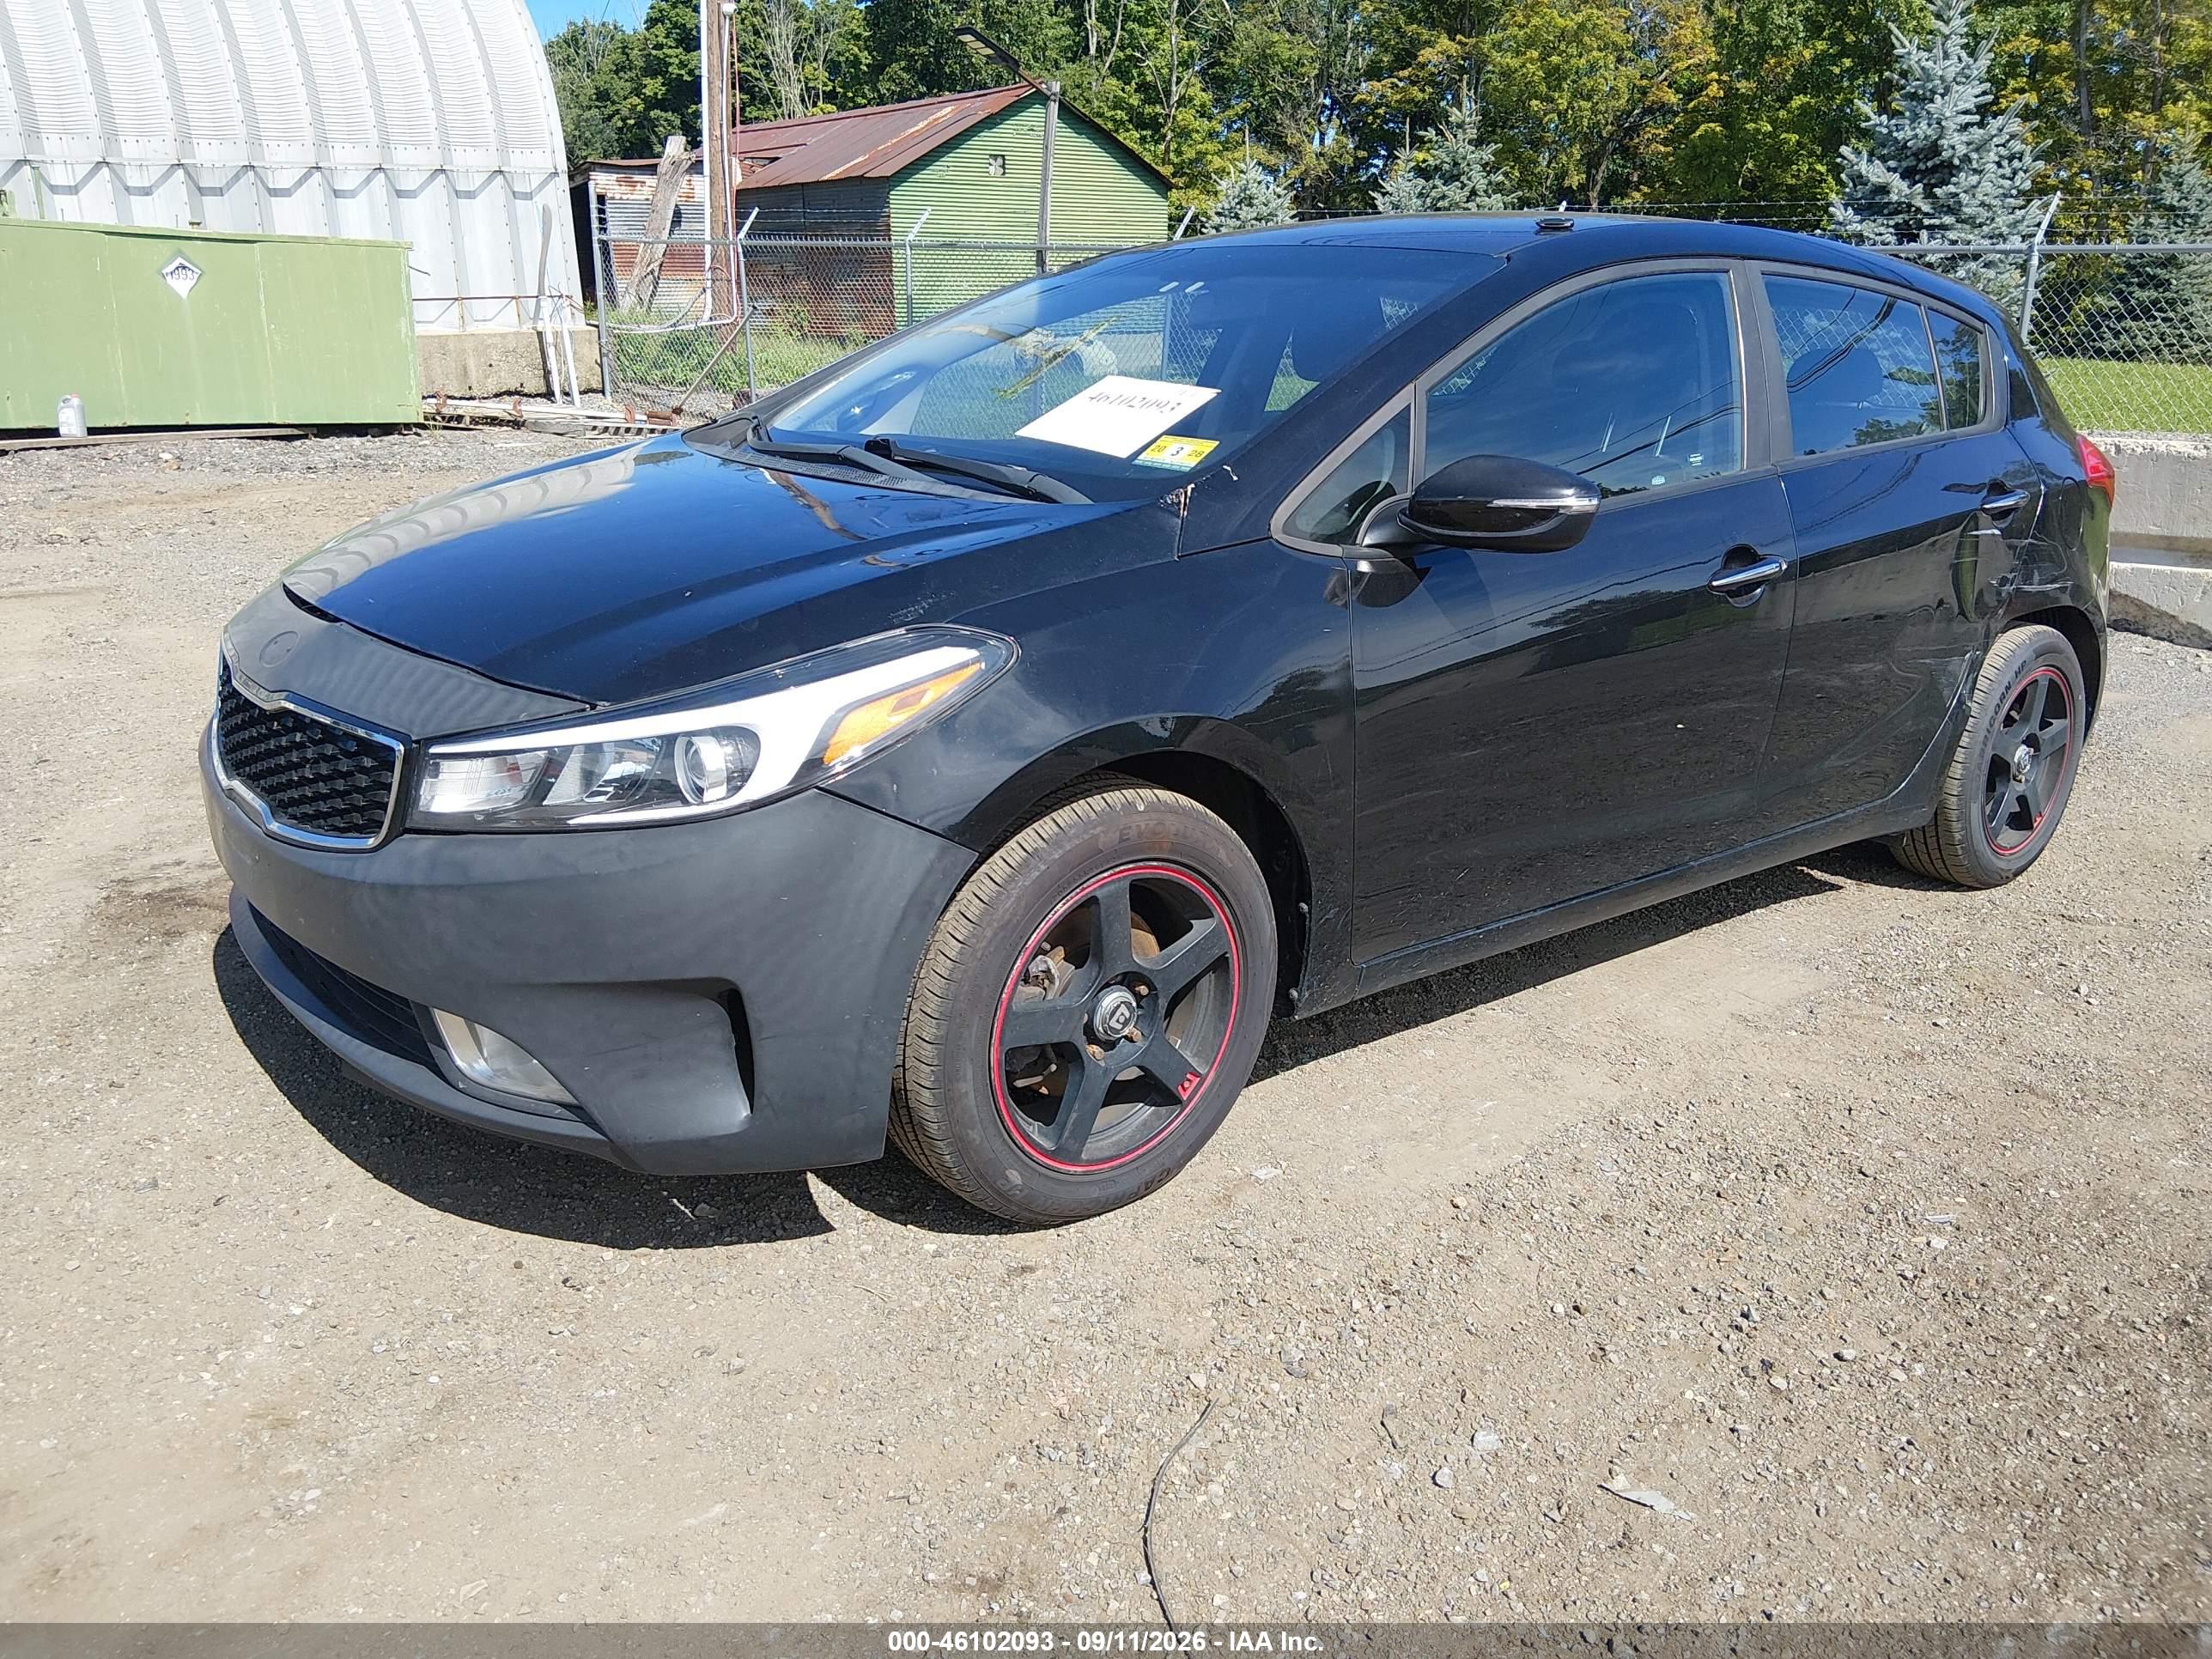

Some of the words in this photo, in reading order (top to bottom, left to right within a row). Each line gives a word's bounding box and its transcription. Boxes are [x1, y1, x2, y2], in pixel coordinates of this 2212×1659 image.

[1088, 392, 1182, 413] 46102093
[1151, 445, 1167, 453] 20
[1170, 446, 1185, 457] 3
[2014, 659, 2027, 679] HP
